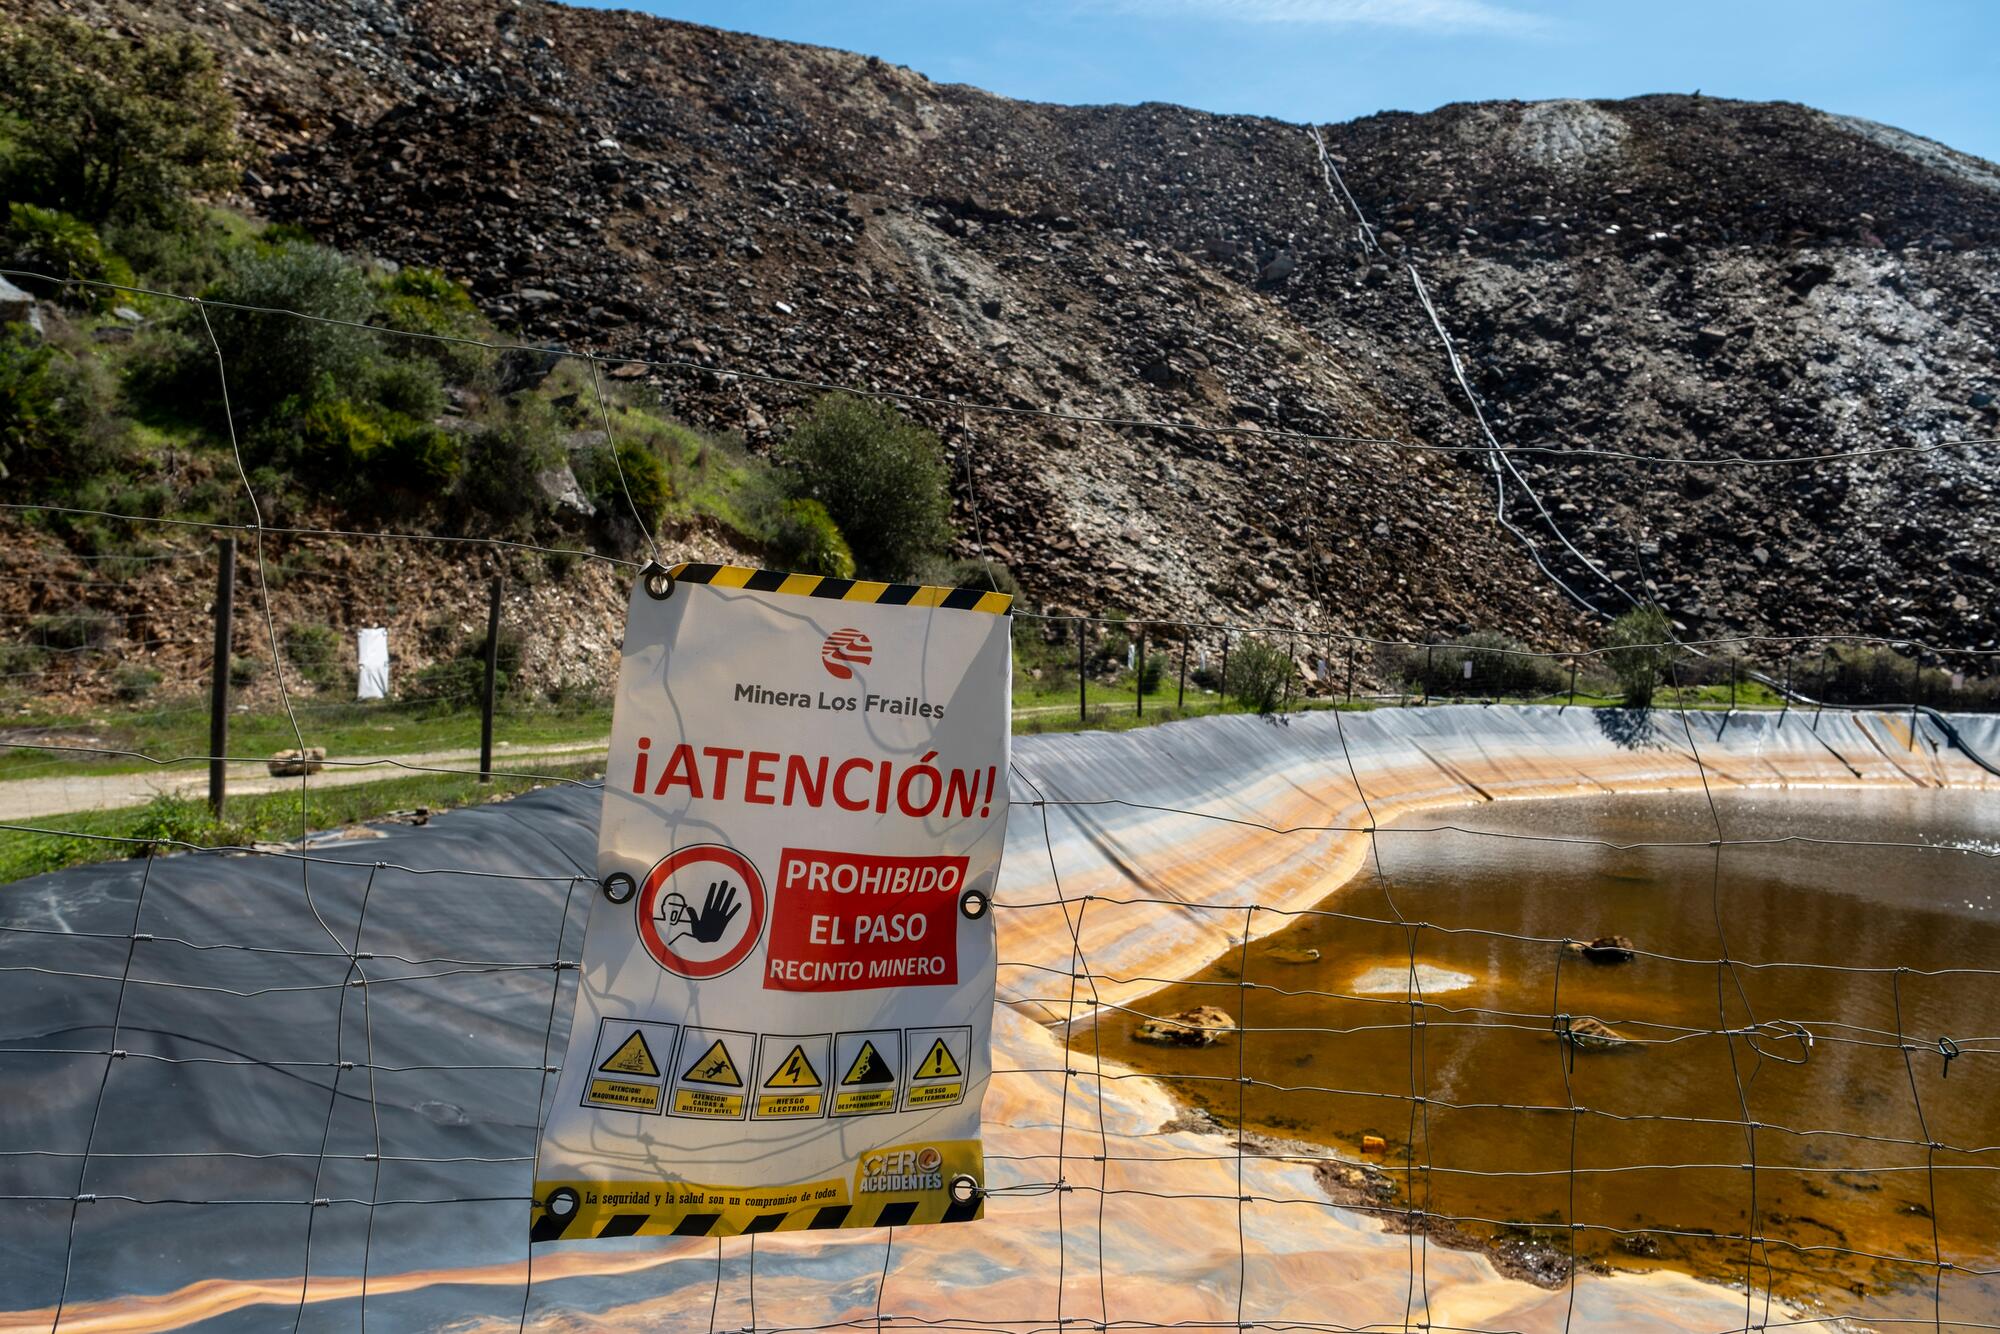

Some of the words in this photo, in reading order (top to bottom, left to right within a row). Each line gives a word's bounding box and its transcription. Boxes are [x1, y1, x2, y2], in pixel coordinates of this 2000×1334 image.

[734, 683, 811, 708] Minera
[818, 691, 857, 712] Los
[864, 694, 944, 719] Frailes
[632, 737, 996, 818] ¡ATENCIÓN!
[785, 859, 960, 894] PROHIBIDO
[809, 915, 845, 945] EL
[854, 913, 927, 944] PASO
[770, 959, 863, 981] RECINTO
[868, 956, 945, 978] MINERO
[592, 1092, 629, 1102] MAQUINARIA
[630, 1097, 654, 1105] PESADA
[838, 1102, 891, 1110] DESPRENDIMIENTO
[910, 1093, 958, 1102] INDETERMINADO
[768, 1105, 810, 1113] ELECTRICO
[859, 1173, 942, 1193] ACCIDENTES
[586, 1191, 598, 1204] La
[602, 1191, 650, 1205] seguridad
[654, 1195, 661, 1206] y
[665, 1192, 674, 1204] la
[679, 1192, 704, 1204] salud
[708, 1195, 724, 1204] son
[729, 1197, 741, 1205] un
[745, 1194, 797, 1208] compromiso
[800, 1191, 811, 1202] de
[814, 1187, 837, 1200] todos
